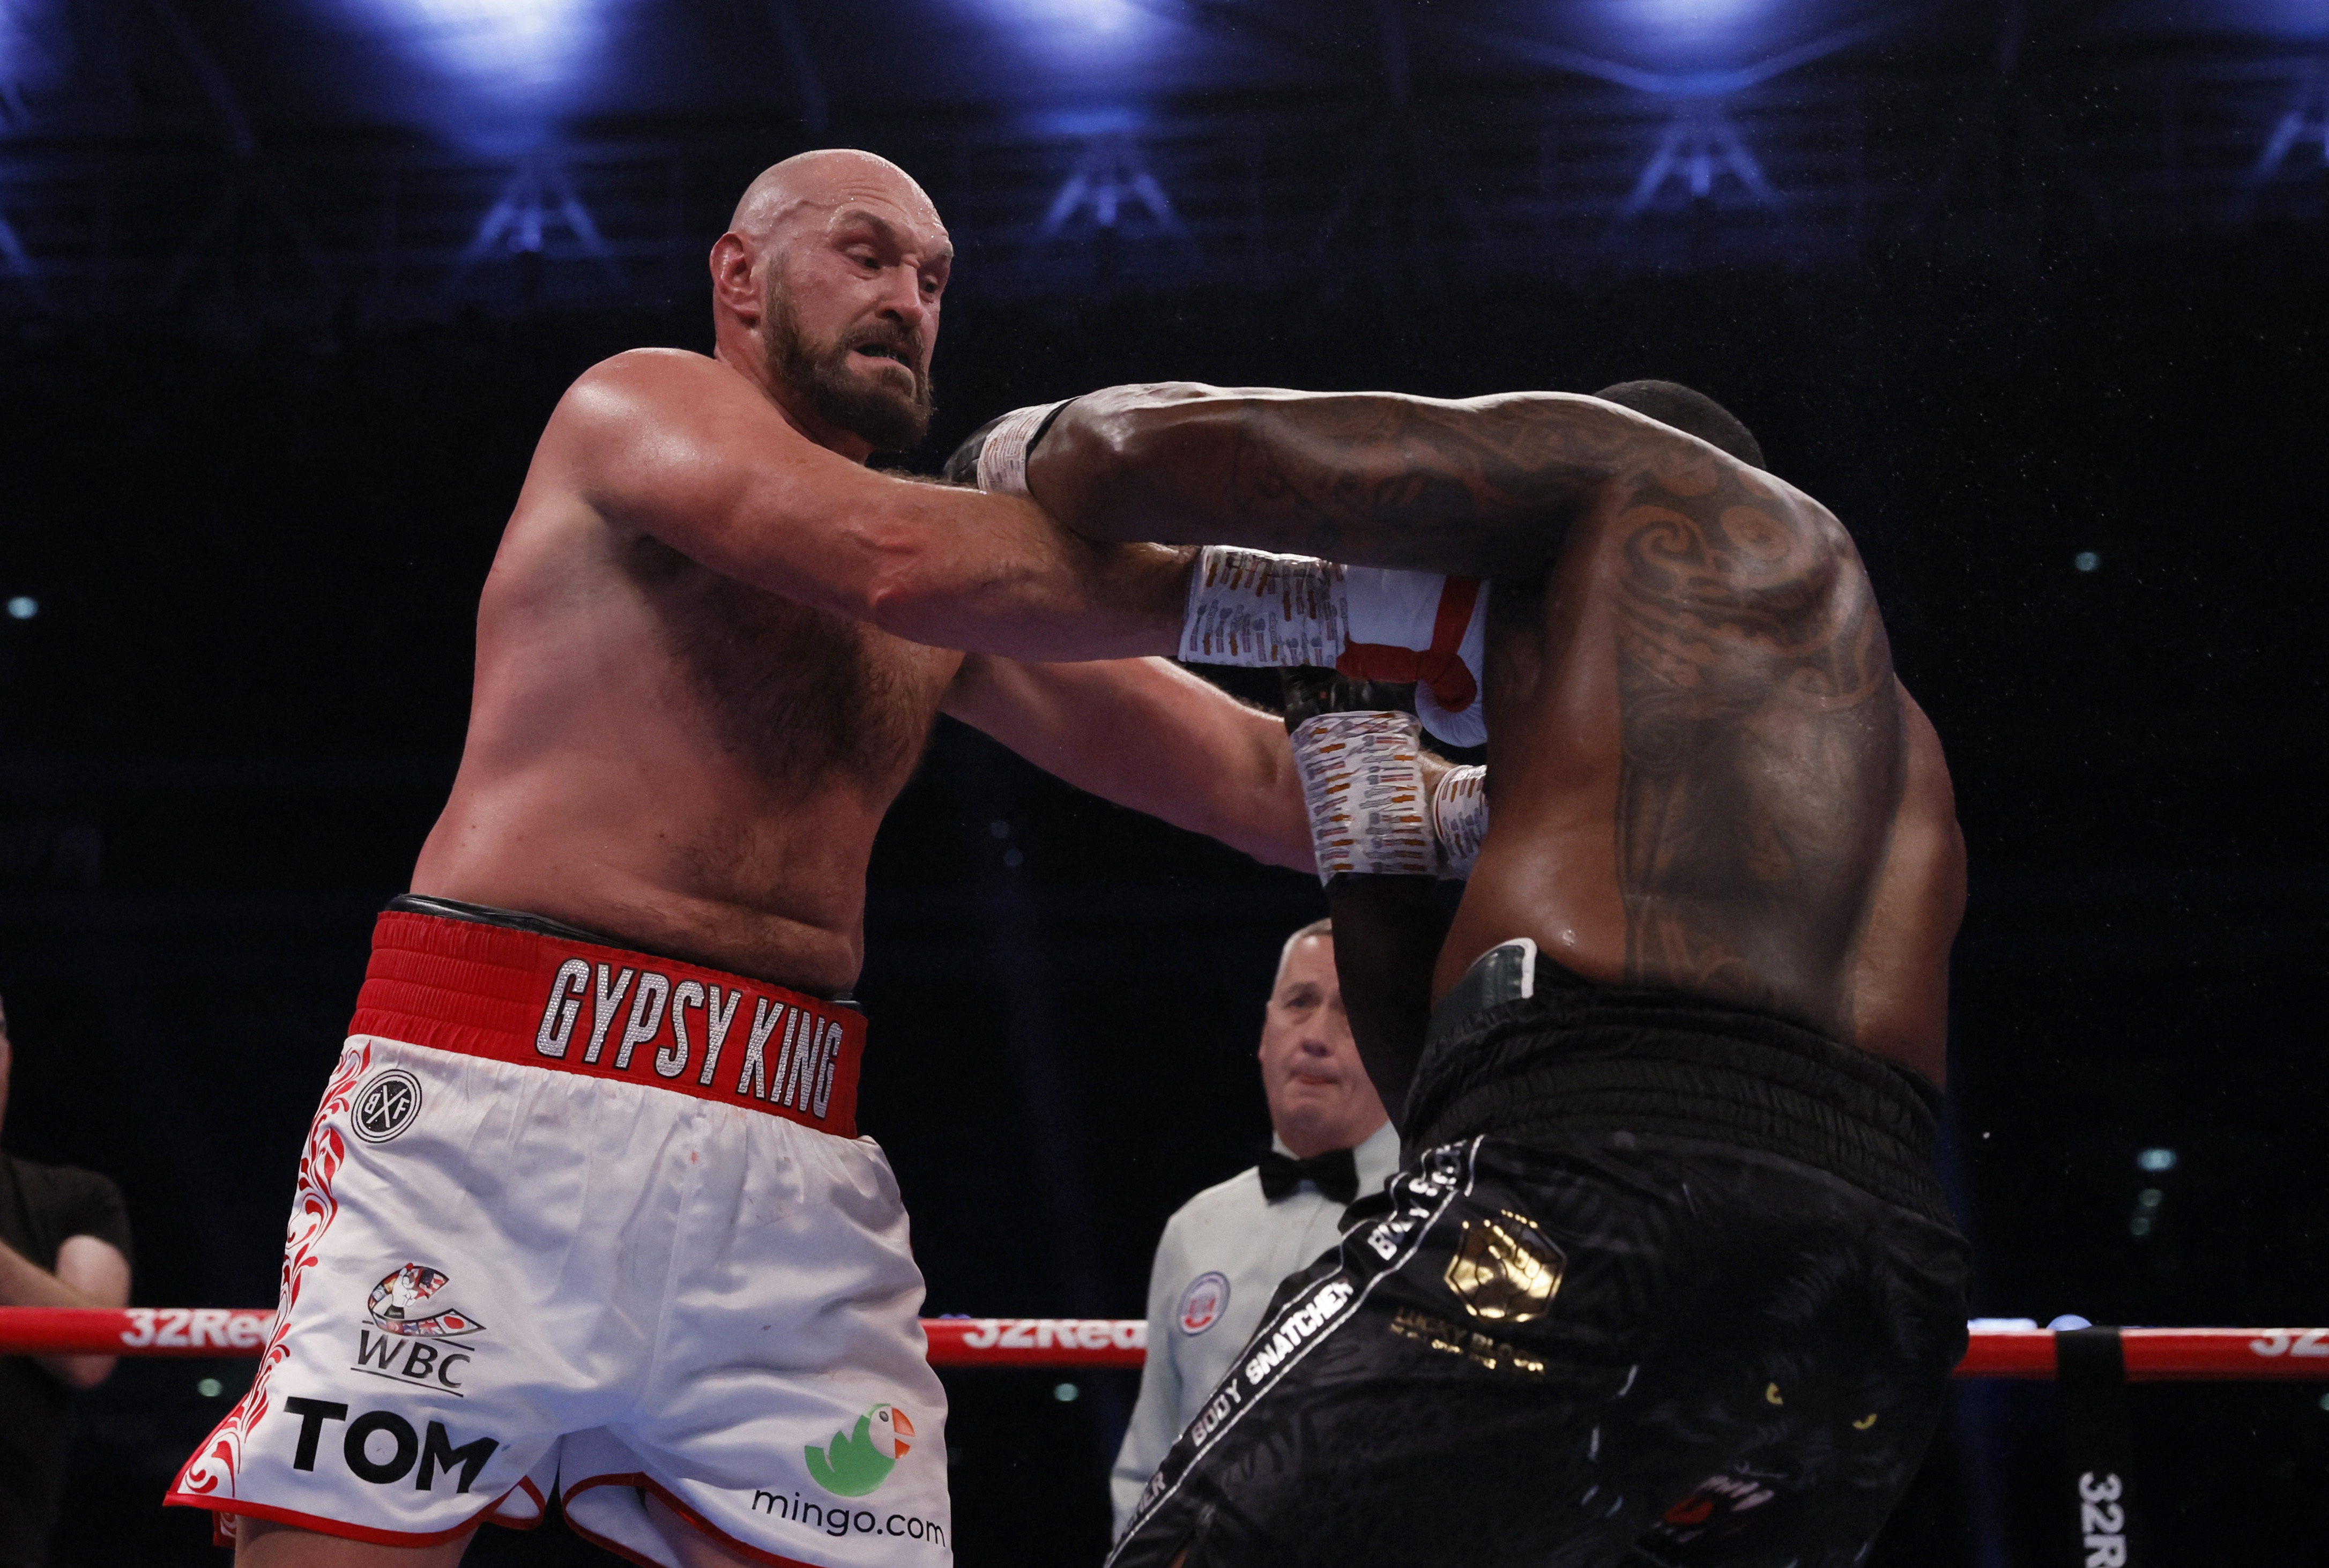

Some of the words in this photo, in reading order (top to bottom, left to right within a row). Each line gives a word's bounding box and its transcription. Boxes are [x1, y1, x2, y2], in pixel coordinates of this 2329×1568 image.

[536, 958, 742, 1086] GYPSY
[737, 997, 844, 1119] KING
[120, 1308, 276, 1348] 32Re
[357, 1329, 471, 1389] WBC
[1191, 1378, 1241, 1447] BODY
[1245, 1277, 1354, 1385] SNATCHER
[284, 1395, 500, 1494] TOM
[751, 1490, 946, 1547] mingo.com
